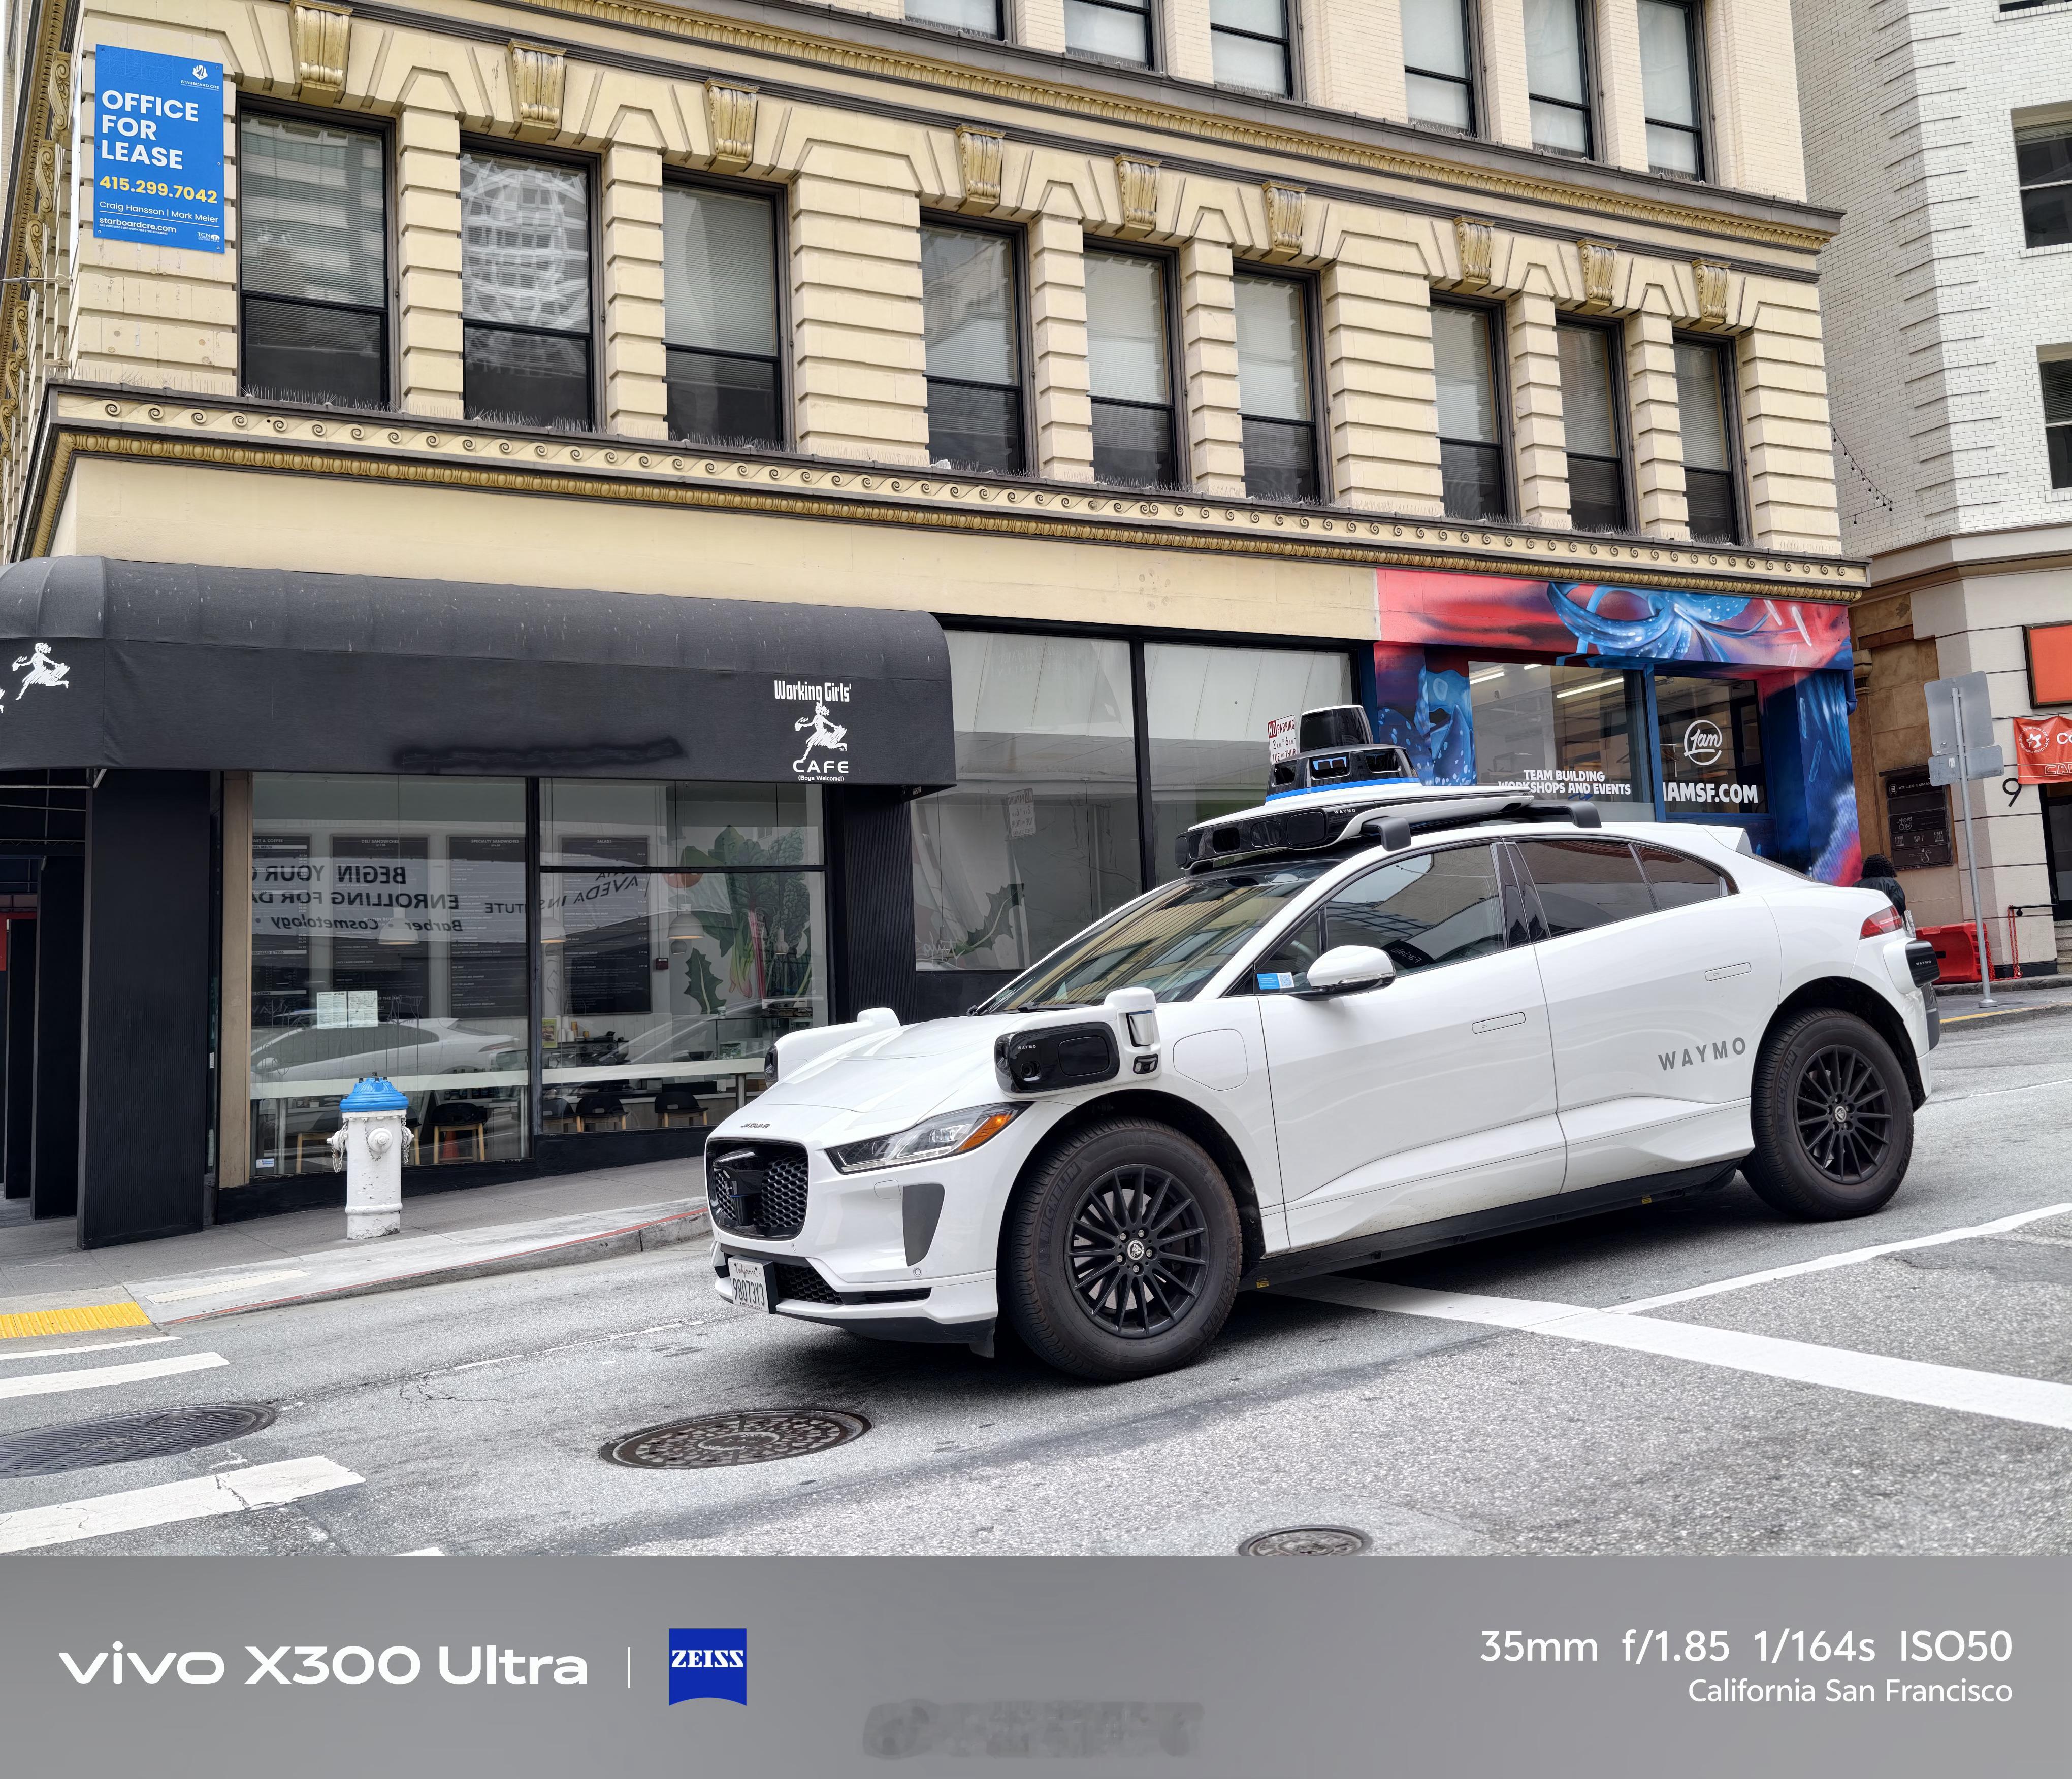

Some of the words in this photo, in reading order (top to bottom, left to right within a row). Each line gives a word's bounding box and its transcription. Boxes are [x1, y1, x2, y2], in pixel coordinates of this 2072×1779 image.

[102, 90, 199, 122] OFFICE
[102, 114, 157, 140] FOR
[102, 140, 183, 170] LEASE
[100, 176, 218, 204] 415.299.7042
[100, 201, 124, 212] Craig
[126, 204, 164, 216] Hansson
[171, 210, 193, 219] Mark
[195, 214, 219, 223] Meier
[99, 217, 177, 233] starboardcre.com
[774, 680, 823, 706] Working
[824, 682, 852, 702] Girls'
[1268, 722, 1276, 737] NO
[1277, 720, 1295, 734] PARKING
[1273, 740, 1276, 750] 2
[1285, 736, 1289, 746] 6
[793, 760, 849, 774] CAFE
[1272, 753, 1280, 763] TUE
[1524, 769, 1553, 781] TEAM
[1556, 770, 1605, 782] BUILDING
[1568, 783, 1591, 794] AND
[1593, 783, 1631, 795] EVENTS
[2002, 778, 2022, 807] 9
[1658, 1037, 1745, 1071] WAYMO
[1039, 1162, 1080, 1241] MICHELIN
[736, 1262, 758, 1278] California
[732, 1277, 765, 1306] 98073Y3
